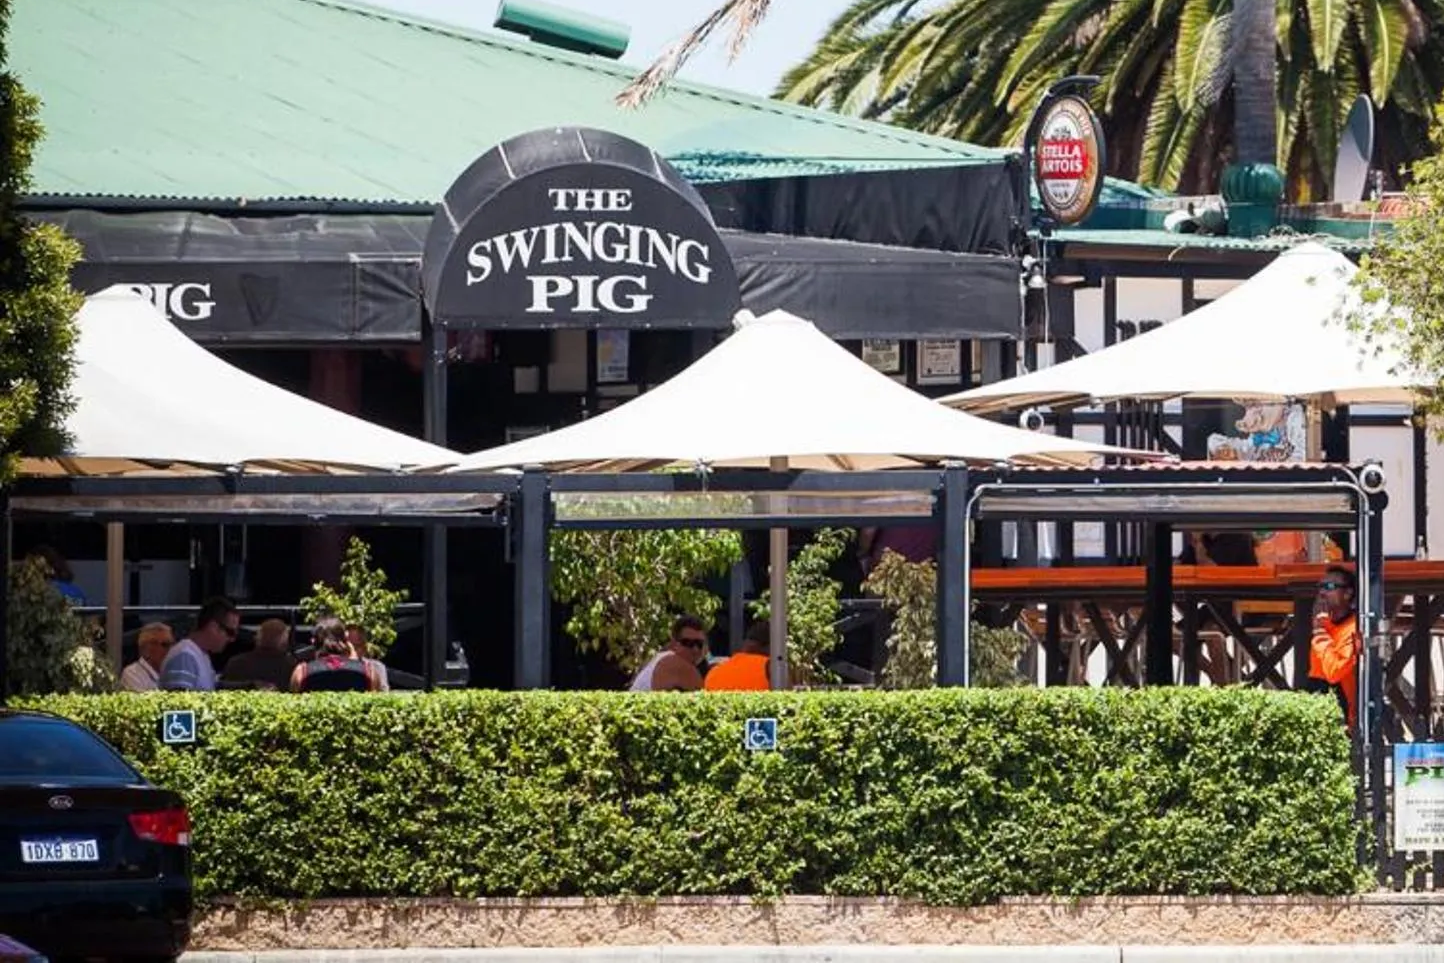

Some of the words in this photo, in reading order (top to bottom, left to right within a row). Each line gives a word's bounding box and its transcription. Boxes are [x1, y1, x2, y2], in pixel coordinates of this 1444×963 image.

[1043, 144, 1081, 158] STELLA
[1042, 159, 1083, 174] ARTOIS
[548, 188, 632, 212] THE
[466, 221, 712, 286] SWINGING
[525, 275, 653, 313] PIG
